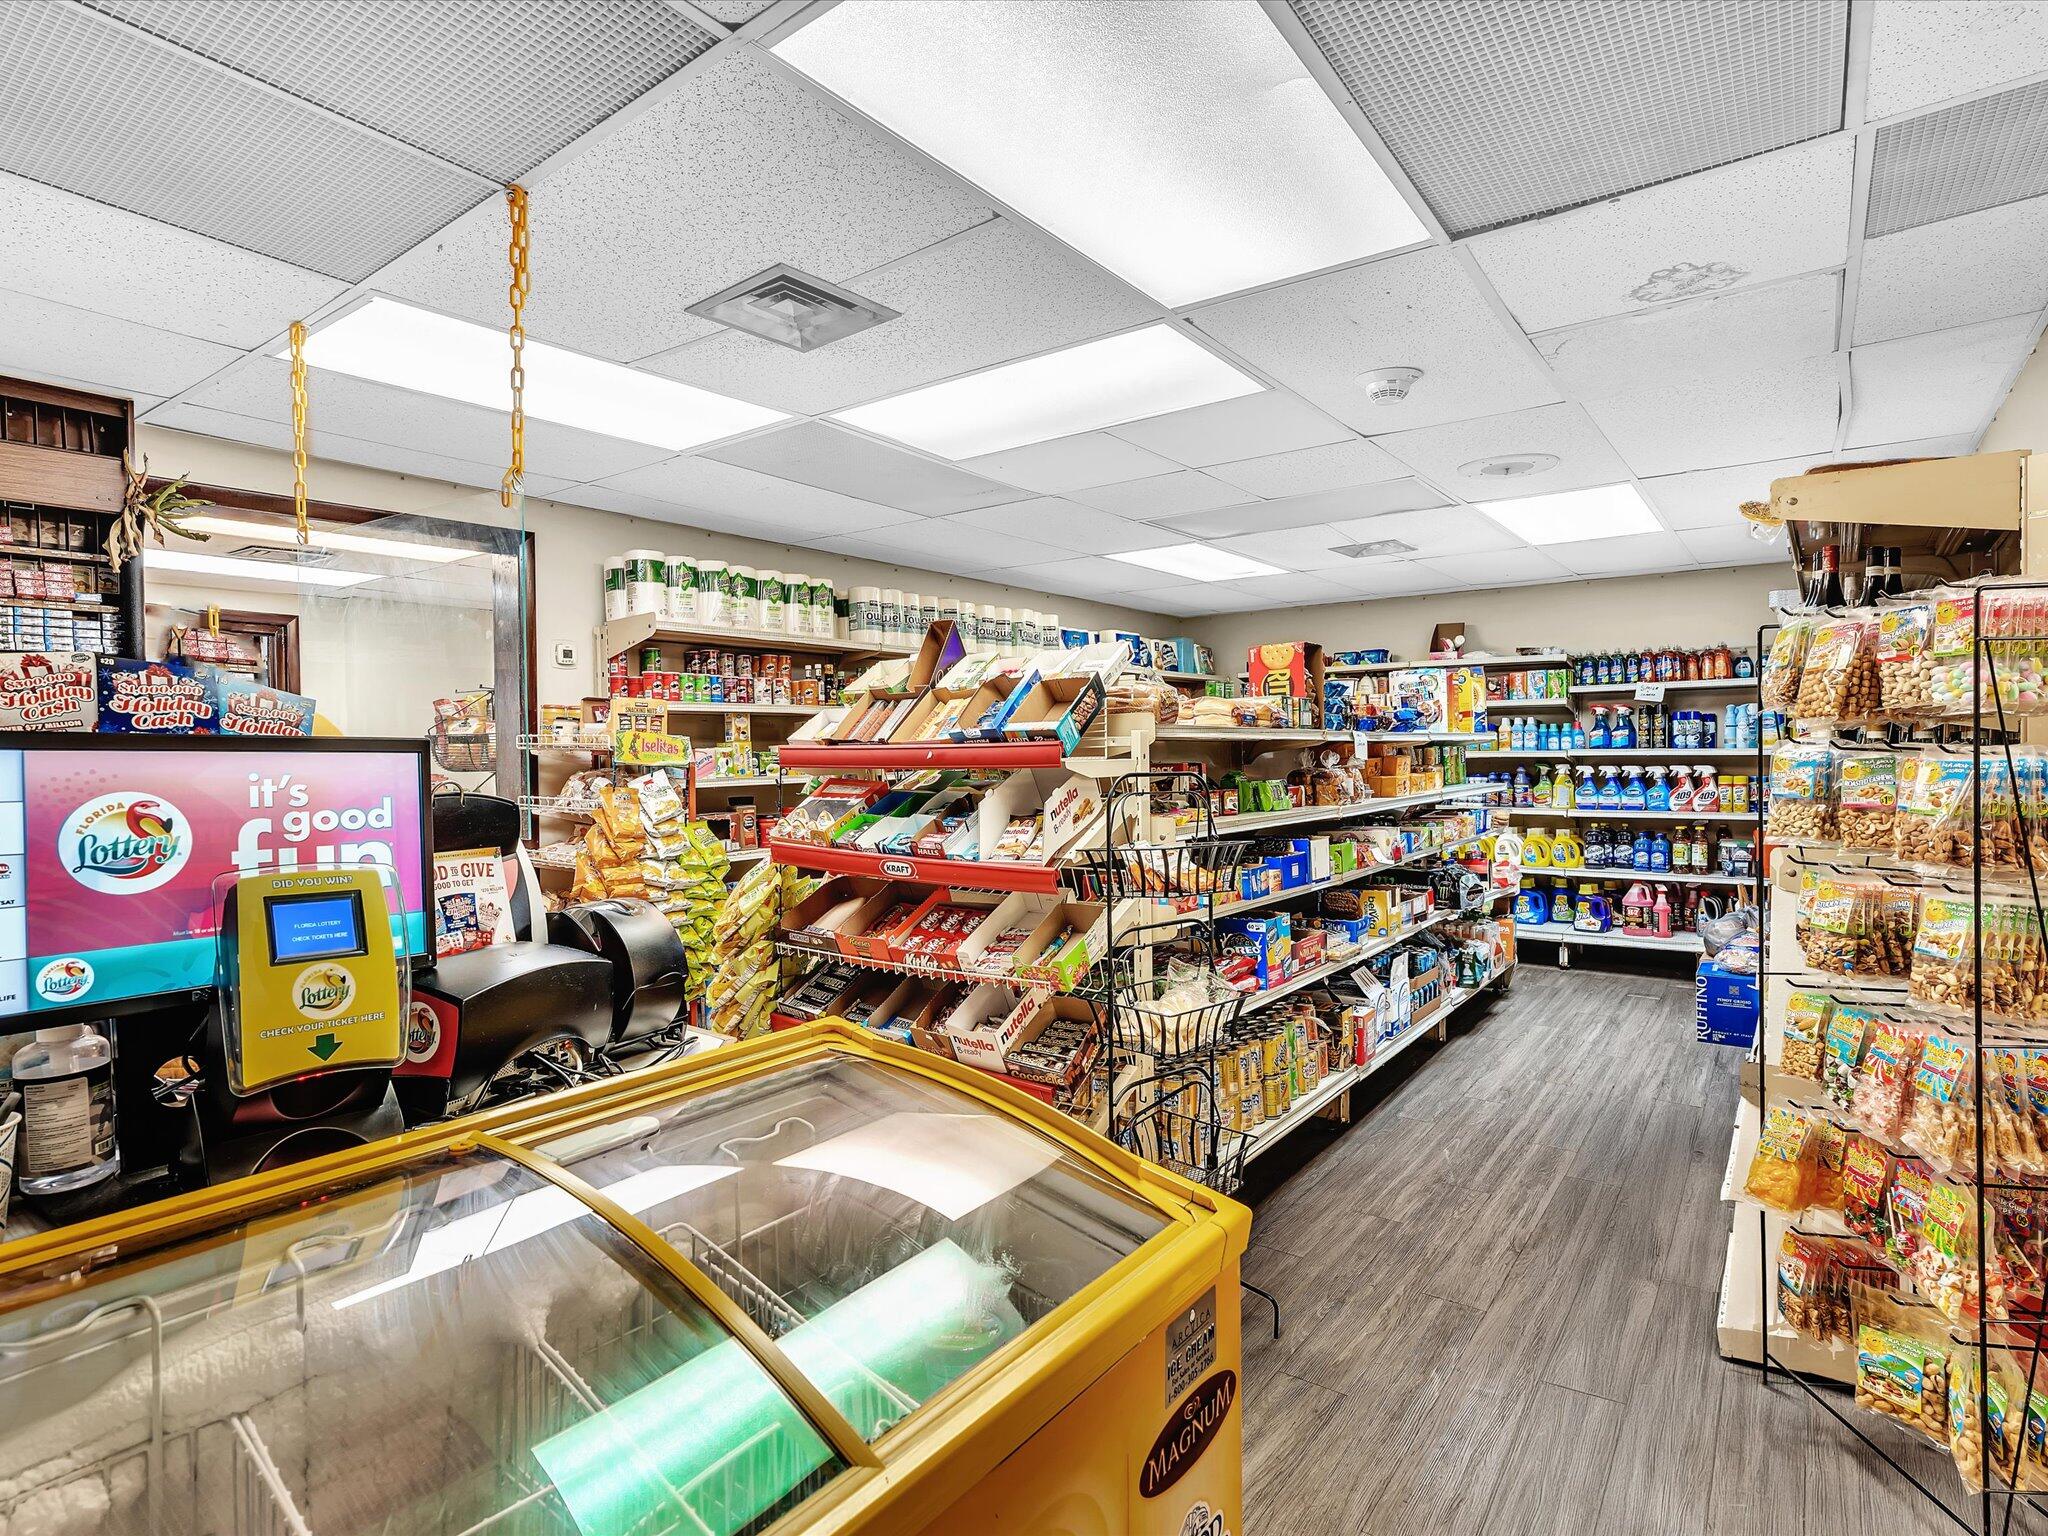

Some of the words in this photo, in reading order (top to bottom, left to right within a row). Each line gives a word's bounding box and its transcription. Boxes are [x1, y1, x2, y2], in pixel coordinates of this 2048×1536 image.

[100, 657, 115, 666] $20
[0, 685, 94, 708] Holiday
[117, 682, 203, 696] $1,000,000
[109, 693, 212, 718] Holiday
[44, 720, 82, 729] MILLION
[641, 738, 680, 755] Iselitas
[248, 771, 310, 810] it's
[1674, 790, 1692, 800] 409
[1699, 790, 1716, 801] 409
[1050, 787, 1079, 822] nutella
[75, 801, 126, 836] FLORIDA
[282, 796, 393, 841] good
[72, 831, 182, 875] Lottery
[918, 847, 940, 856] HALLS
[451, 867, 459, 875] TO
[461, 863, 495, 878] GIVE
[887, 863, 910, 876] KRAFT
[272, 878, 295, 889] DID
[296, 877, 322, 887] YOU
[324, 875, 353, 885] WIN?
[453, 880, 461, 888] TO
[461, 879, 474, 887] GET
[1366, 895, 1379, 931] belVita
[1515, 904, 1531, 914] XTRA
[1575, 911, 1590, 921] XTRA
[293, 921, 317, 929] FLORIDA
[317, 919, 341, 927] LOTTERY
[311, 933, 333, 942] TICKETS
[334, 931, 349, 939] HERE
[1223, 945, 1261, 957] OREO
[905, 952, 938, 973] KitKat
[41, 974, 89, 996] Lottery
[299, 983, 351, 1010] Lottery
[1696, 976, 1711, 1041] RUFFINO
[260, 1026, 294, 1039] CHECK
[296, 1021, 325, 1034] YOUR
[326, 1016, 358, 1030] TICKET
[360, 1011, 385, 1023] HERE
[1001, 997, 1035, 1045] nutella
[952, 1034, 995, 1052] nutella
[1168, 1353, 1183, 1381] ICE
[1186, 1322, 1215, 1363] CREAM
[1180, 1366, 1190, 1379] Sales
[1148, 1376, 1232, 1493] MAGNUM
